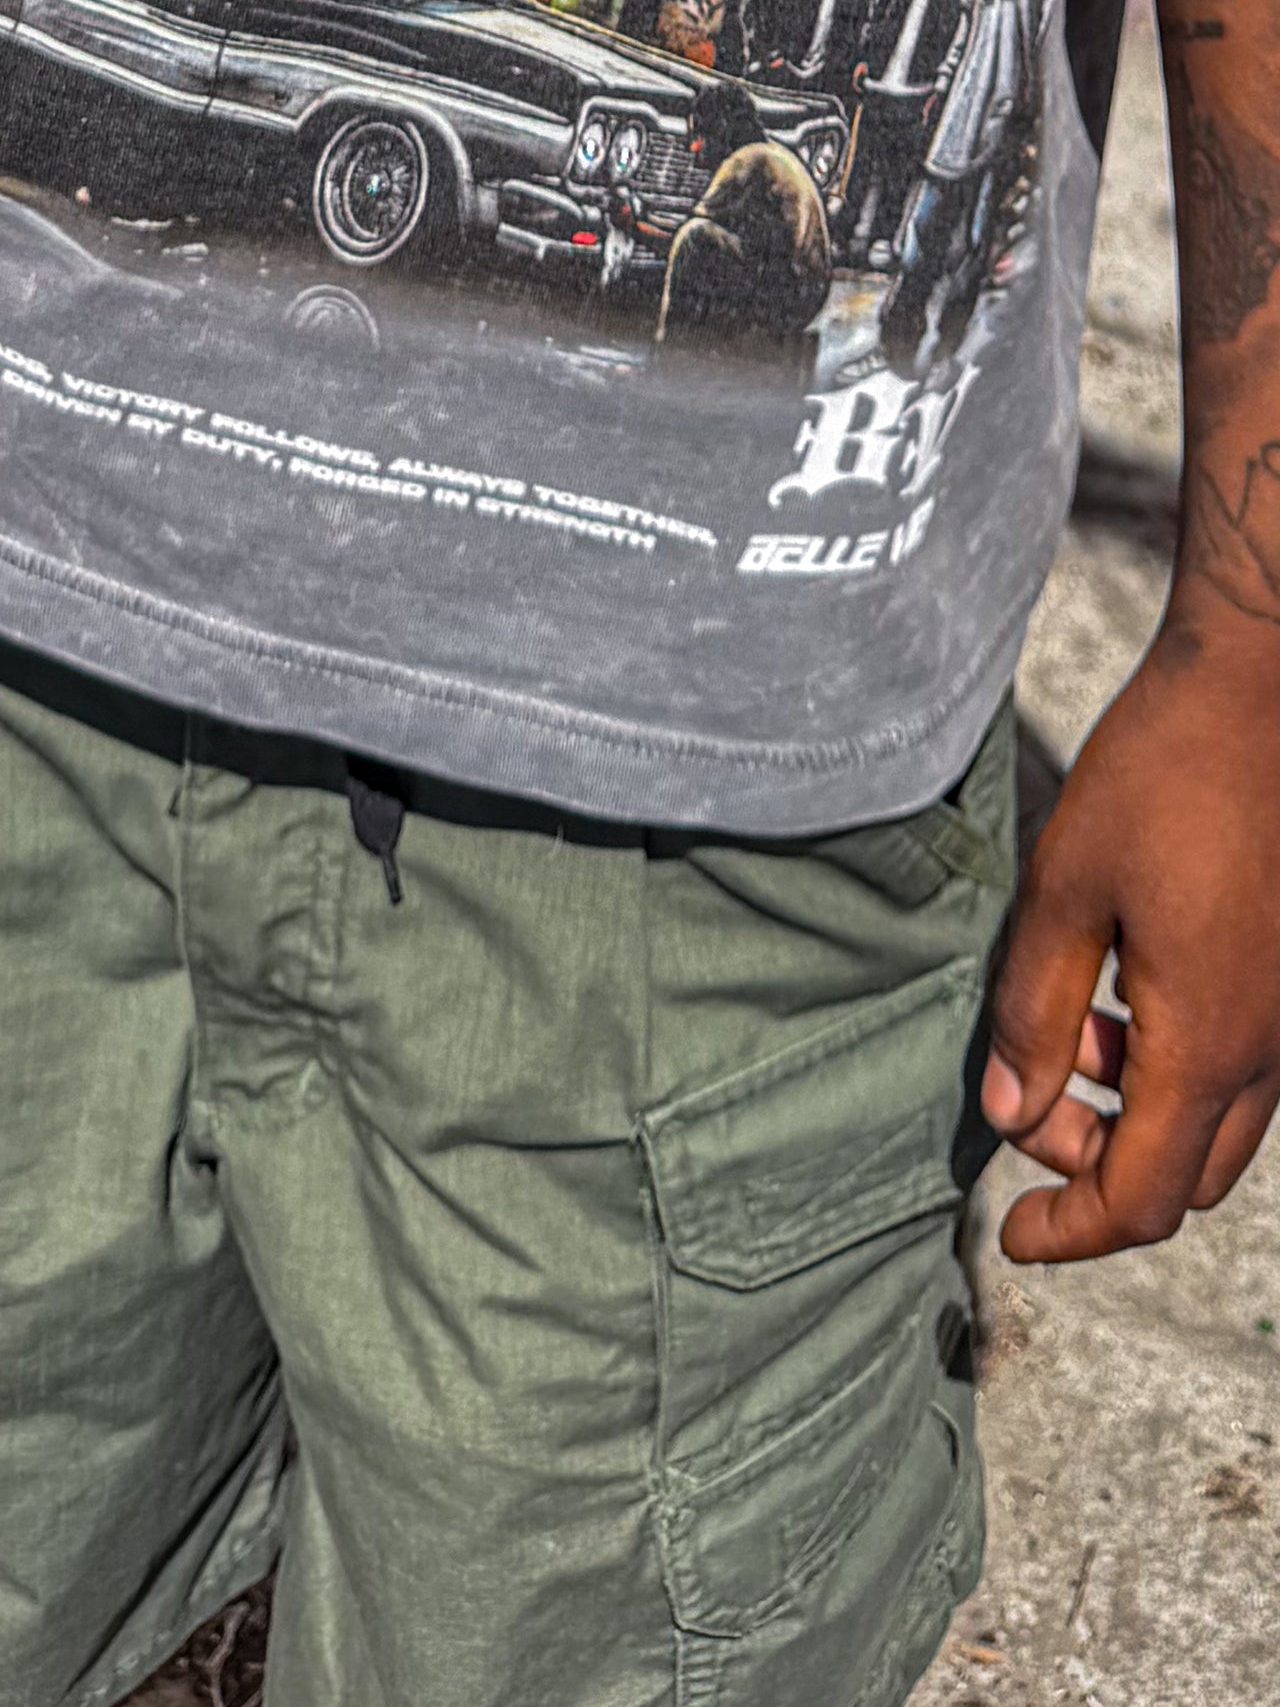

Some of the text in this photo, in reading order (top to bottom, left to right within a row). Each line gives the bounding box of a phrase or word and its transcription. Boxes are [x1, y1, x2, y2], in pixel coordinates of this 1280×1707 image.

[0, 369, 121, 423] DRIVEN
[127, 413, 178, 435] BY
[181, 428, 283, 471] DUTY,
[288, 456, 427, 498] FORGED
[432, 486, 470, 508] IN
[475, 495, 657, 550] STRENGTH
[62, 371, 207, 422] VICTORY
[389, 457, 526, 498] ALWAYS
[736, 529, 889, 572] BELLE
